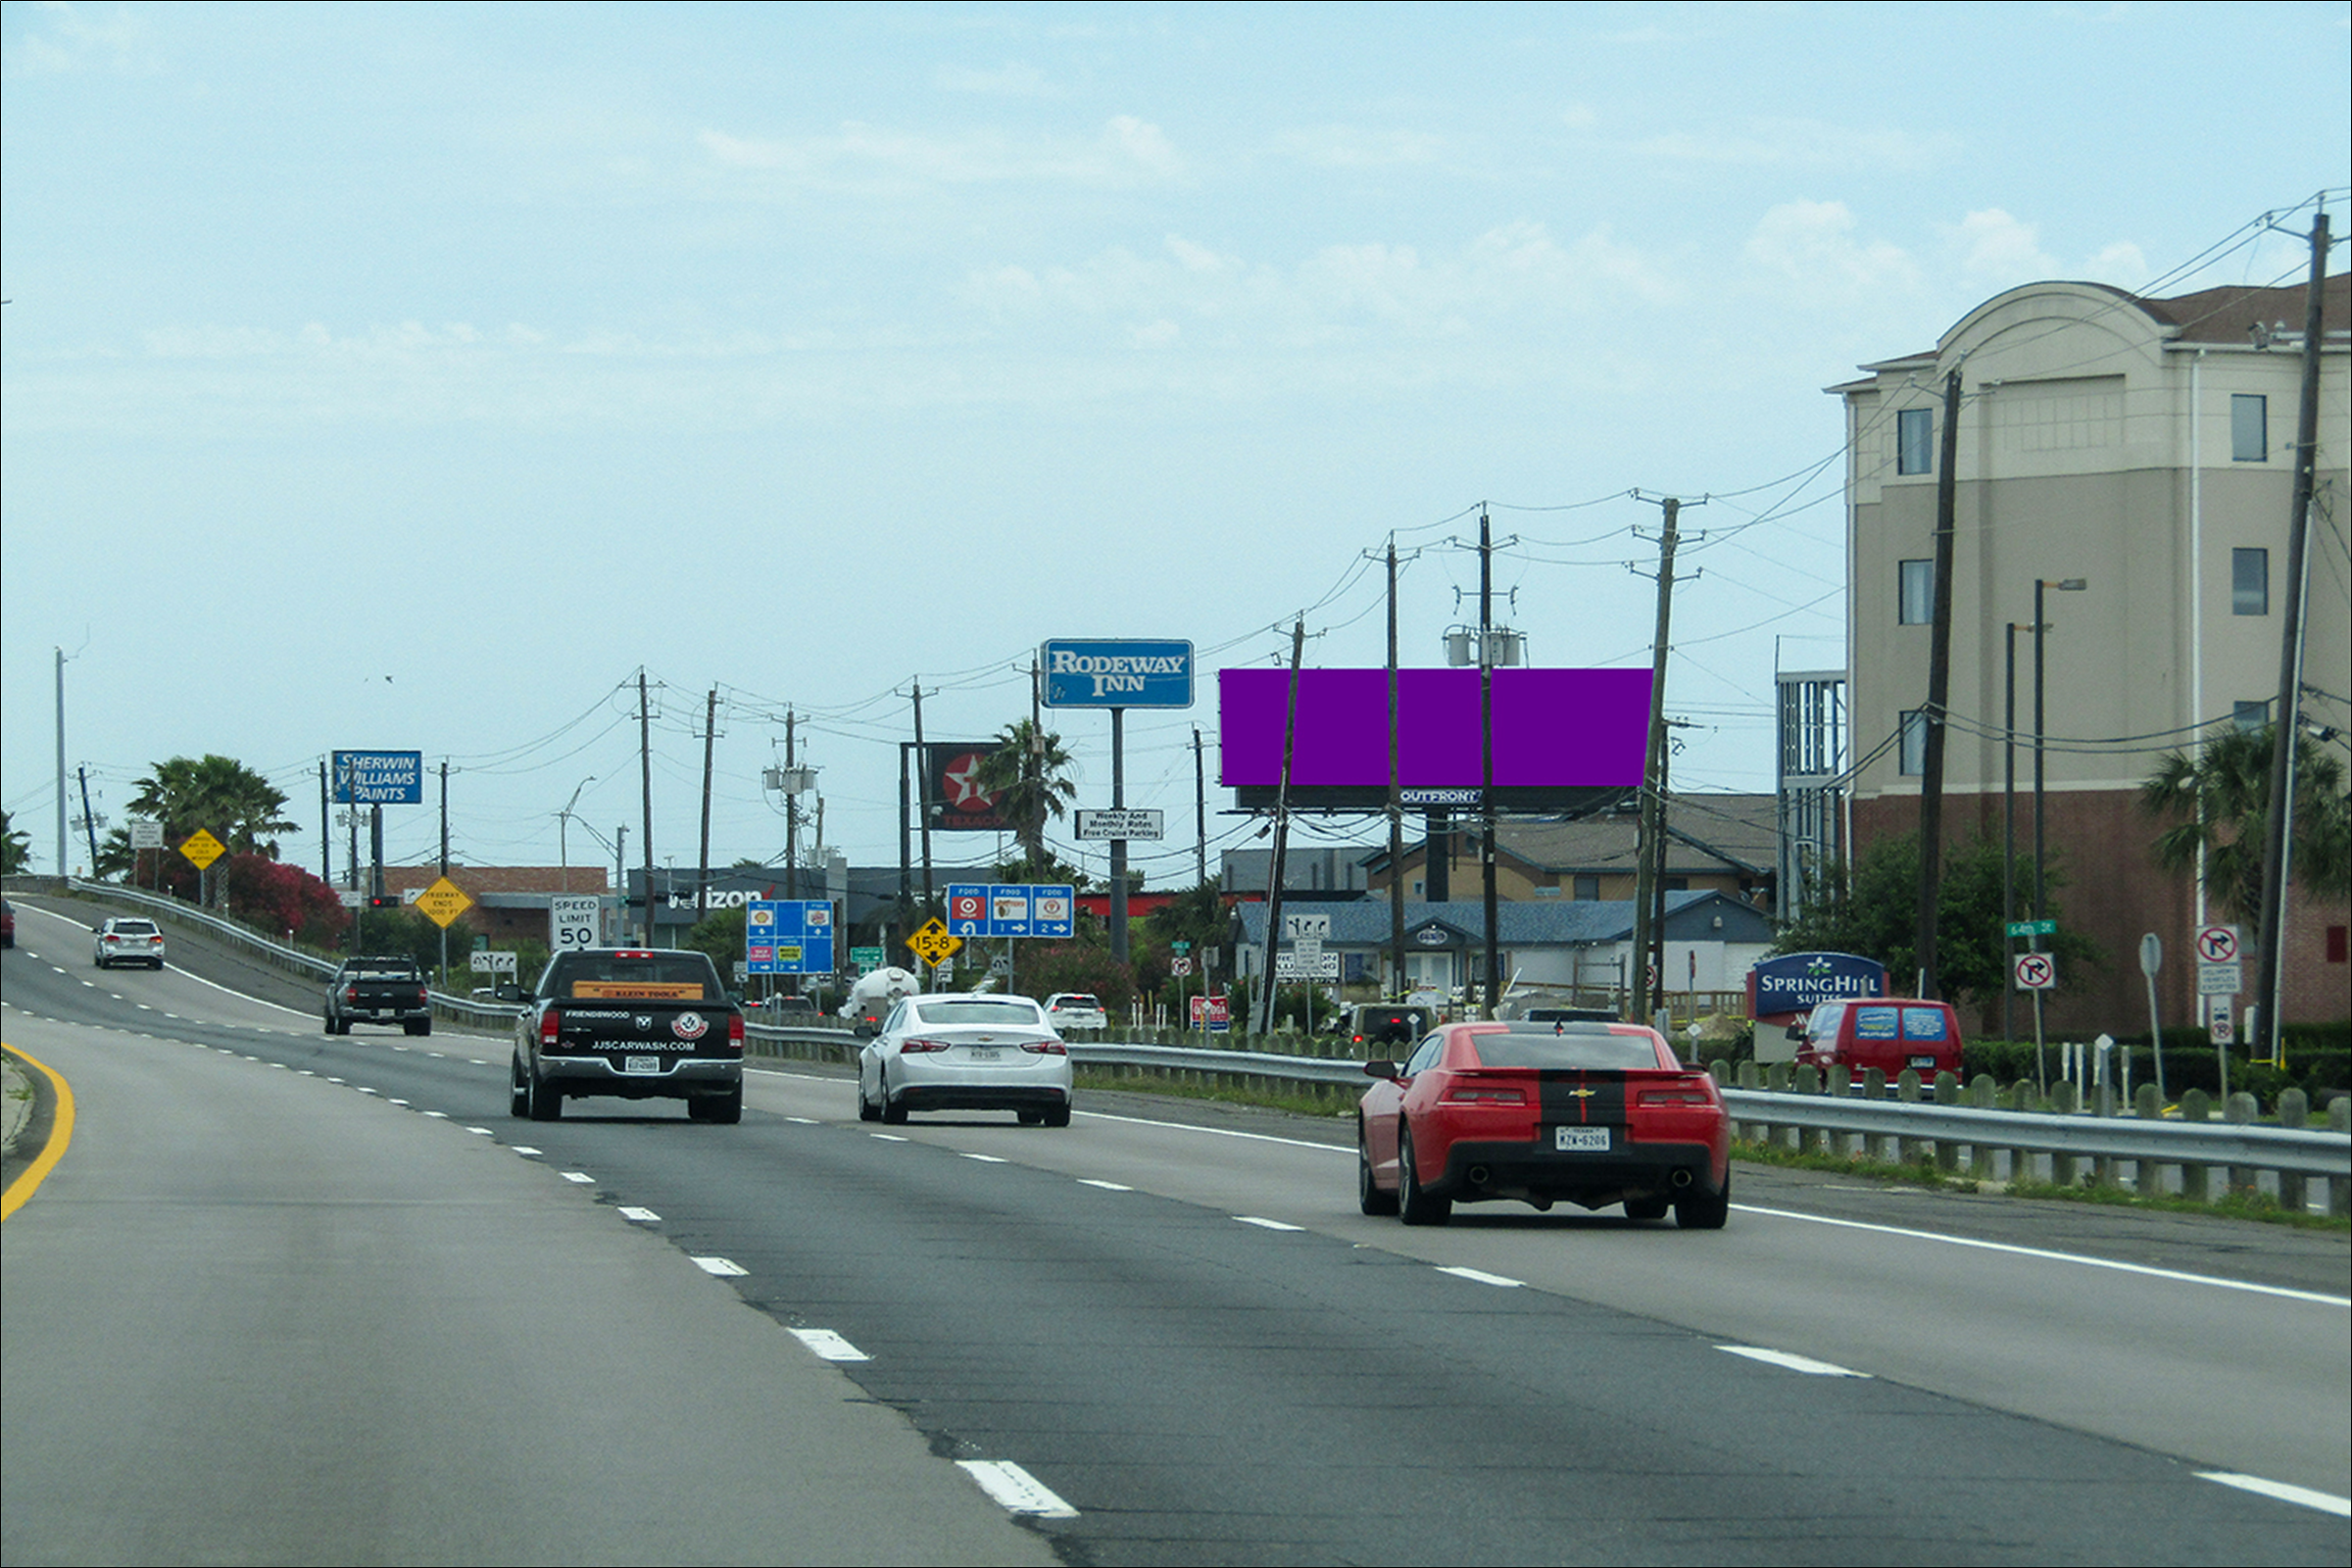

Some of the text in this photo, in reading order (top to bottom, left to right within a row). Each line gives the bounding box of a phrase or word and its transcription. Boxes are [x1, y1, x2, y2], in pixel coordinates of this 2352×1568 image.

[1052, 651, 1186, 674] RODEWAY
[1092, 674, 1146, 697] INN
[341, 754, 416, 769] SHERWIN
[339, 770, 416, 785] WILLIAMS
[555, 901, 597, 910] SPEED
[559, 913, 592, 923] LIMIT
[561, 927, 593, 945] 50
[915, 936, 951, 950] 15-8
[565, 1009, 630, 1019] FRIENDSWOOD
[592, 1041, 696, 1052] JJSCARWASH.COM
